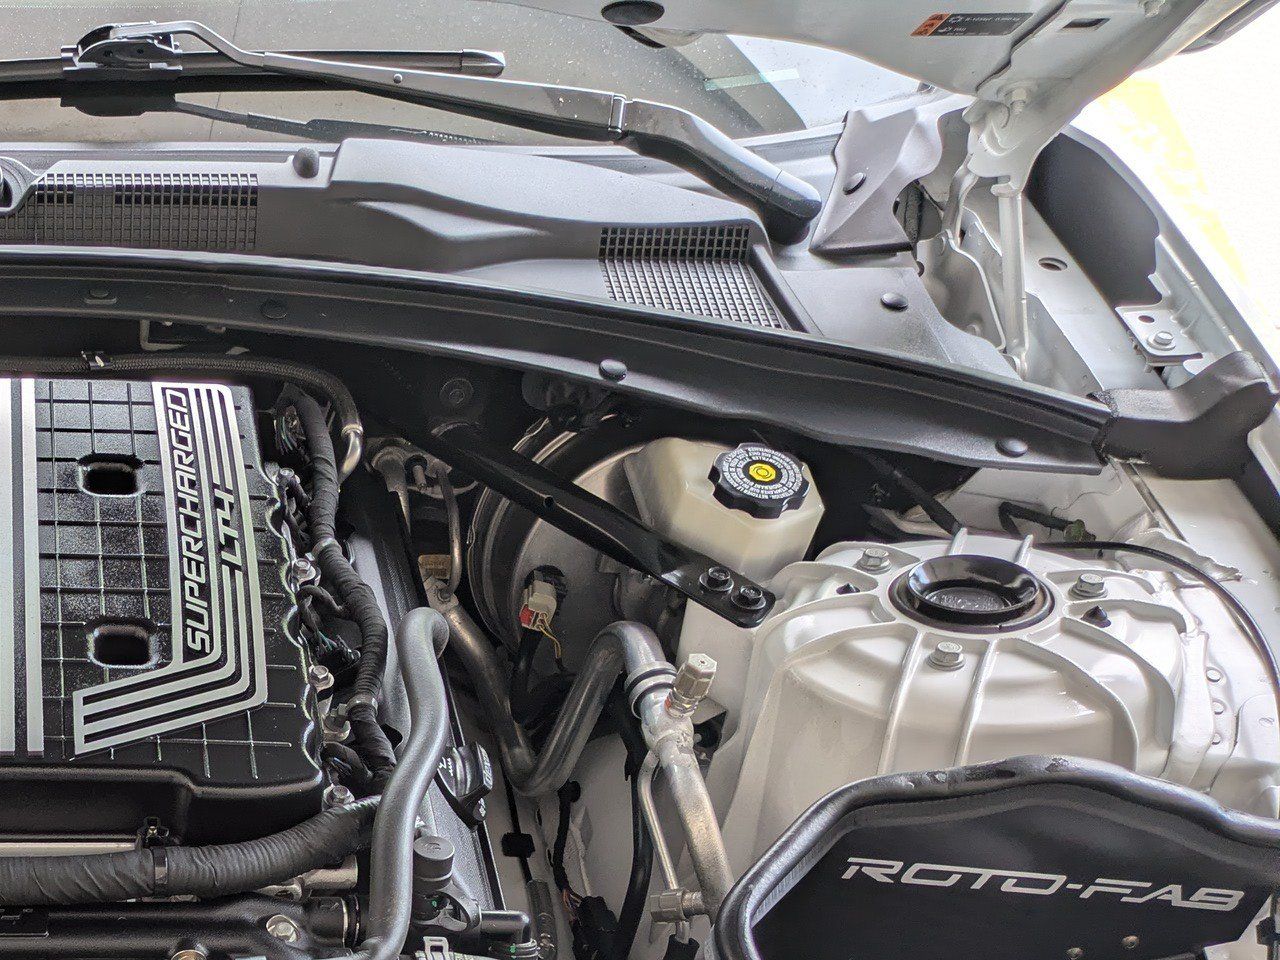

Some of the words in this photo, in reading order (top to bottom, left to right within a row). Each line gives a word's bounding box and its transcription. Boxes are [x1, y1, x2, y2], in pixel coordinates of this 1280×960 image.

[168, 389, 211, 654] SUPERCHARGED
[214, 487, 243, 570] LT4
[841, 857, 1246, 912] ROTO-FAB
